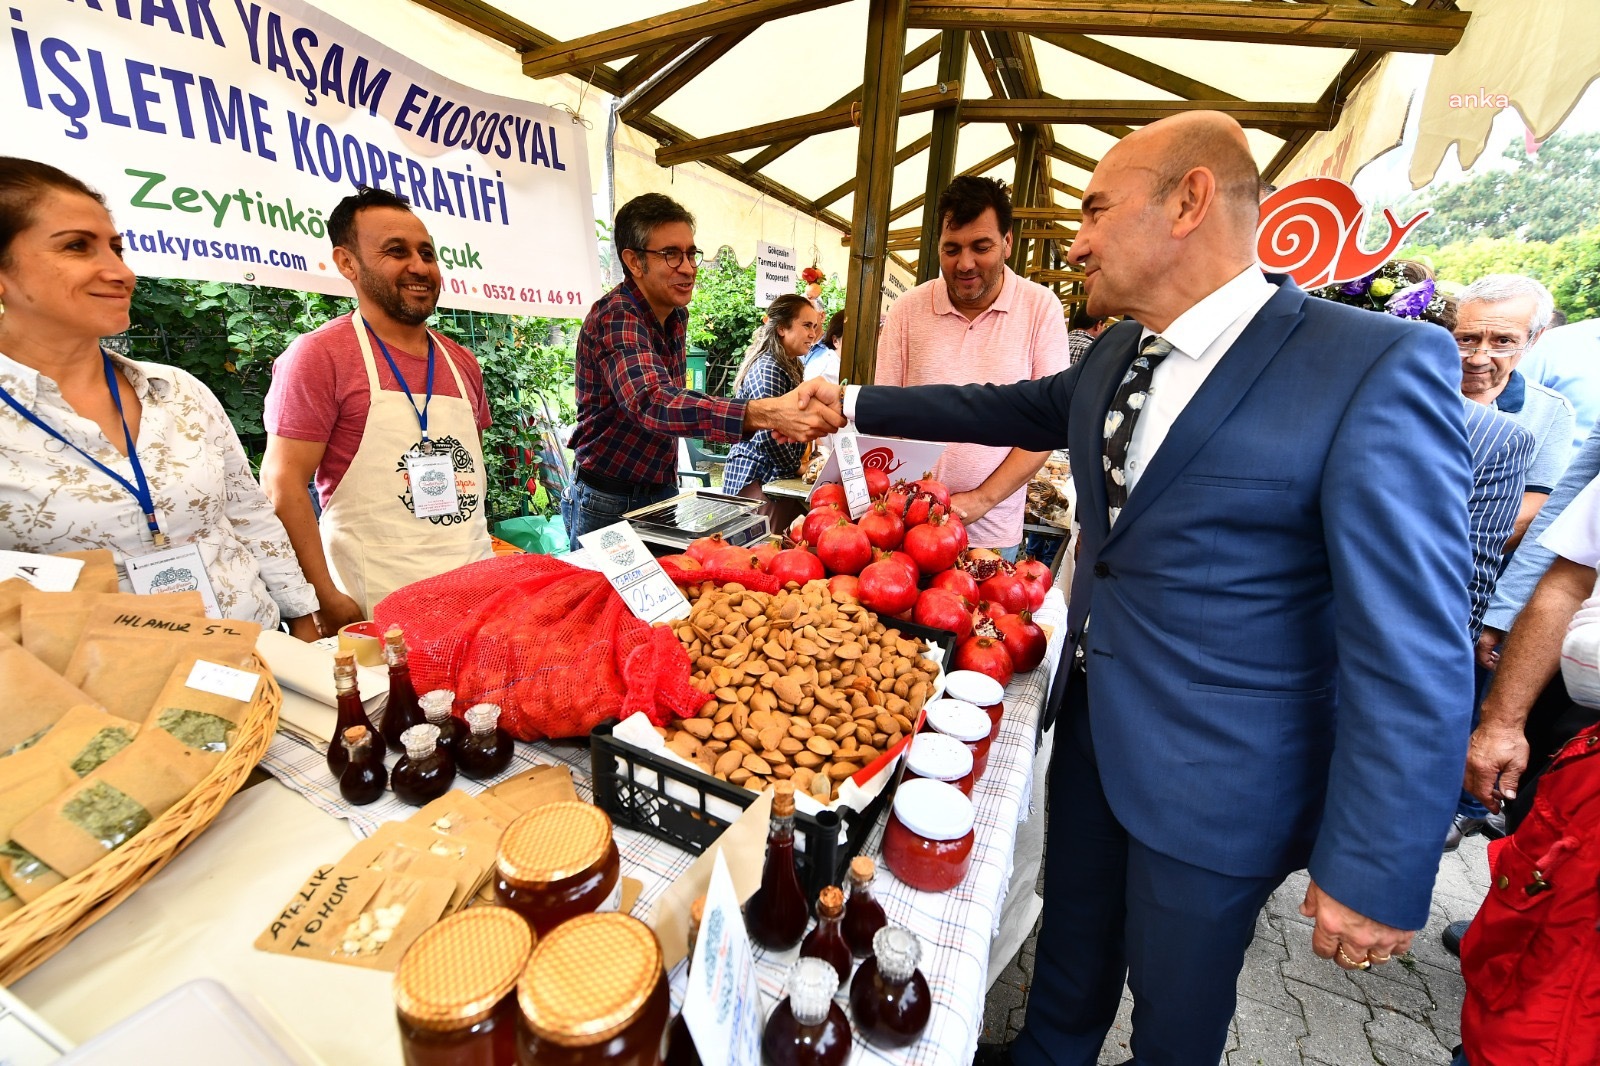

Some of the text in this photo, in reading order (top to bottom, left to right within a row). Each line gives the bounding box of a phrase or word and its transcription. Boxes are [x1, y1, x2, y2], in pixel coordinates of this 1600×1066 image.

[9, 7, 509, 225] İŞLETME KOOPERATİFİ
[234, 0, 392, 117] YAŞAM
[394, 84, 566, 171] EKOSOSYAL
[124, 168, 329, 239] Zeytinkö
[450, 278, 467, 295] 01
[483, 283, 516, 302] 0532
[520, 288, 542, 303] 621
[548, 290, 563, 304] 46
[567, 291, 582, 305] 91
[758, 257, 778, 268] Tarımsal
[113, 613, 191, 633] IHLAMUR
[202, 624, 221, 636] 5
[290, 875, 358, 951] TOHUM
